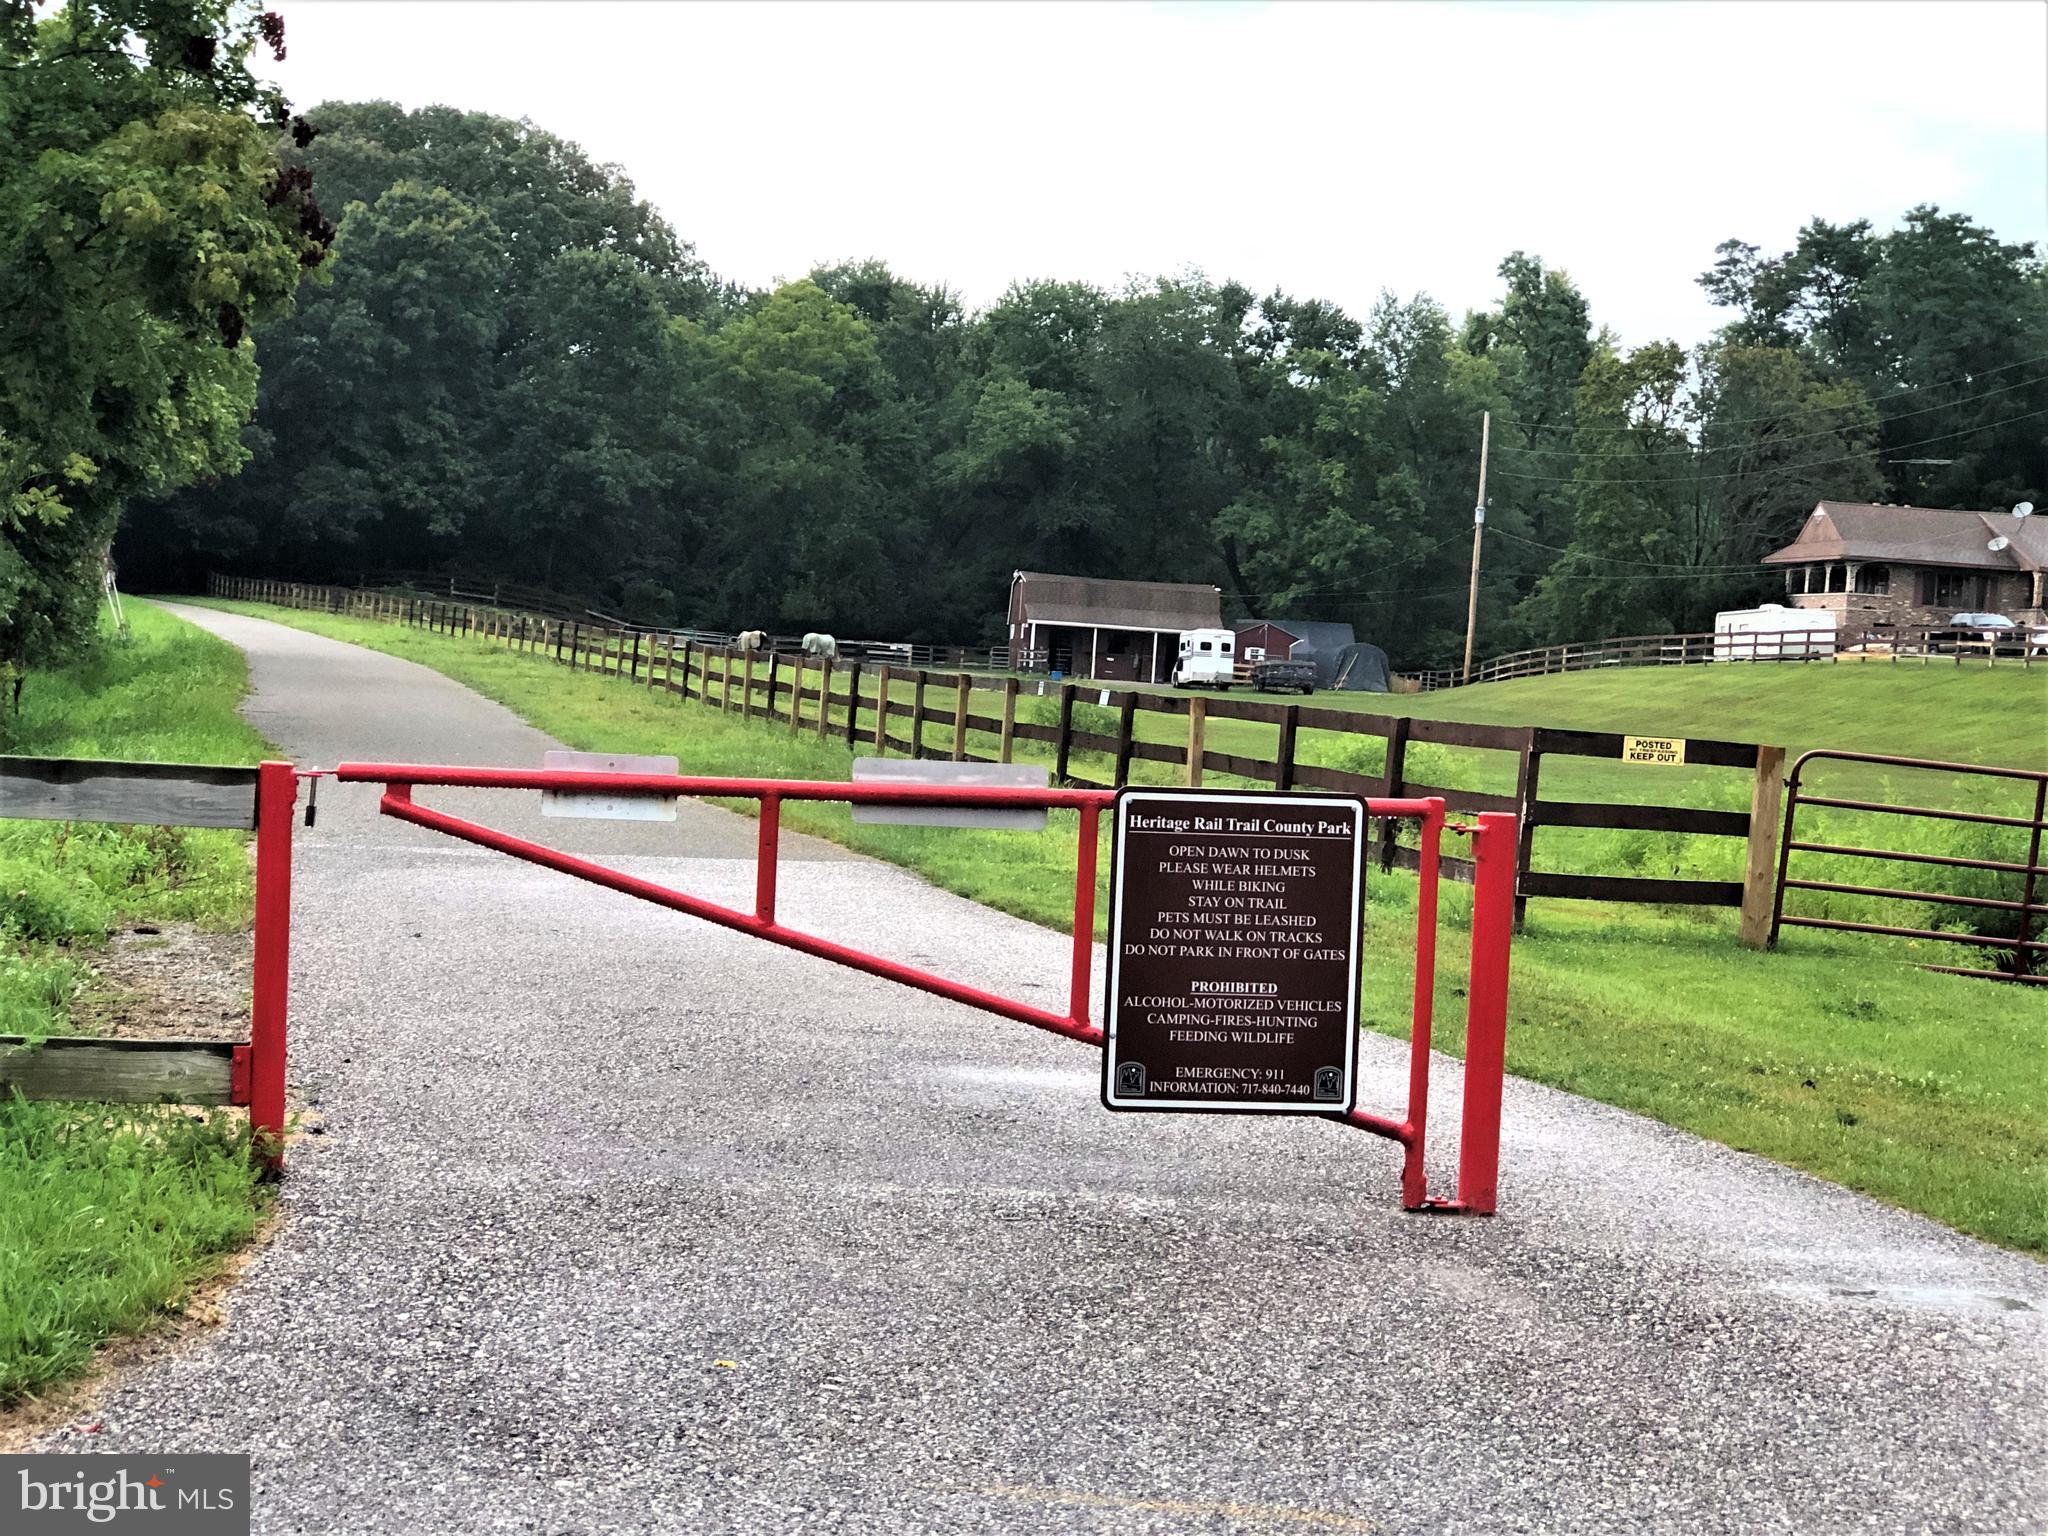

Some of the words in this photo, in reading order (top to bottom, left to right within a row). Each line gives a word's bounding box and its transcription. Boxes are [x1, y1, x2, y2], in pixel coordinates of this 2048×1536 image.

[1636, 740, 1672, 749] POSTED
[1630, 752, 1654, 760] KEEP
[1130, 815, 1190, 832] Heritage
[1194, 817, 1222, 830] Rail
[1227, 819, 1259, 832] Trail
[1263, 820, 1314, 836] County
[1318, 822, 1351, 834] Park
[1169, 845, 1205, 857] OPEN
[1209, 847, 1249, 858] DAWN
[1253, 848, 1271, 859] TO
[1274, 849, 1310, 860] DUSK
[1159, 862, 1208, 874] PLEASE
[1212, 863, 1250, 875] WEAR
[1254, 865, 1316, 877] HELMETS
[1192, 880, 1235, 891] WHILE
[1239, 881, 1285, 893] BIKING
[1189, 896, 1221, 907] STAY
[1225, 897, 1244, 908] ON
[1248, 898, 1287, 909] TRAIL
[1158, 912, 1189, 923] PETS
[1193, 913, 1231, 924] MUST
[1235, 914, 1251, 925] BE
[1255, 915, 1317, 926] LEASHED
[1150, 928, 1170, 939] DO
[1173, 930, 1201, 940] NOT
[1206, 930, 1242, 941] WALK
[1246, 931, 1266, 942] ON
[1270, 932, 1323, 943] TRACKS
[1125, 944, 1145, 955] DO
[1148, 945, 1177, 956] NOT
[1180, 946, 1215, 957] PARK
[1218, 947, 1232, 958] IN
[1235, 948, 1280, 959] FRONT
[1283, 949, 1300, 960] OF
[1303, 949, 1346, 961] GATES
[1191, 981, 1278, 994] PROHIBITED
[1124, 996, 1274, 1010] ALCOHOL-MOTORIZED
[1277, 1000, 1342, 1012] VEHICLES
[1147, 1013, 1317, 1028] CAMPING-FIRES-HUNTING
[1170, 1030, 1228, 1042] FEEDING
[1231, 1032, 1295, 1044] WILDLIFE
[1176, 1067, 1262, 1080] EMERGENCY:
[1266, 1069, 1284, 1080] 911
[1150, 1081, 1240, 1095] INFORMATION:
[1242, 1083, 1310, 1095] 717-840-7440
